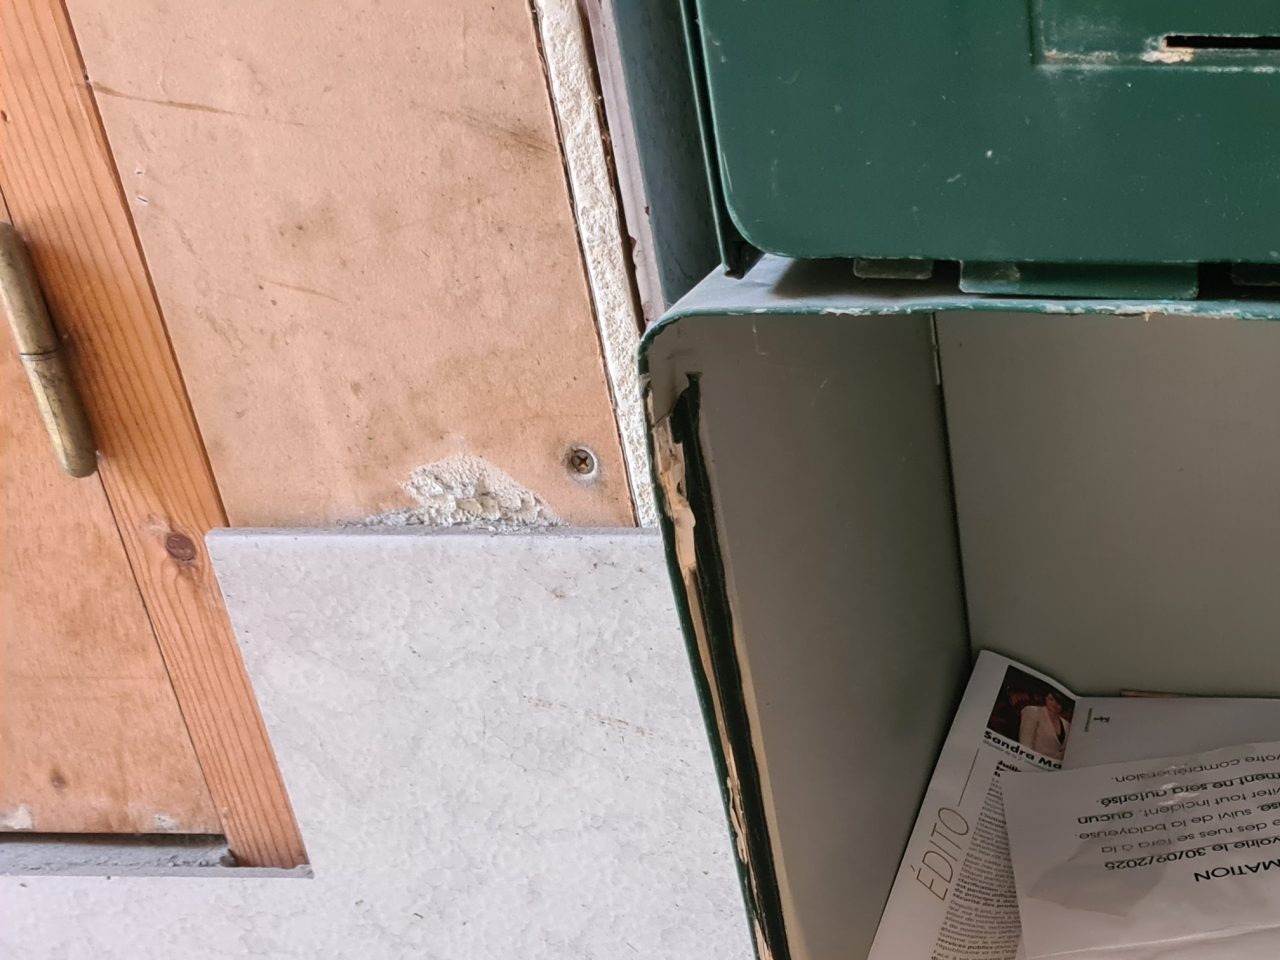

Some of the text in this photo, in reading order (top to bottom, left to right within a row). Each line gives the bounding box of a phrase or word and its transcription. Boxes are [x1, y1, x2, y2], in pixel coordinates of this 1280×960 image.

[983, 730, 1035, 762] Sandra
[1110, 757, 1240, 784] compréhension.
[1172, 782, 1209, 795] sera
[1212, 777, 1234, 790] ne
[1096, 786, 1169, 808] autorisé.
[1214, 792, 1248, 806] tout
[1138, 797, 1211, 818] incident,
[1217, 808, 1253, 820] suivi
[1077, 810, 1134, 825] aucun
[1190, 813, 1213, 825] de
[1074, 822, 1167, 841] balayeuse.
[1171, 820, 1187, 830] la
[1237, 820, 1267, 832] des
[1177, 833, 1195, 842] se
[1199, 827, 1233, 838] rues
[1101, 844, 1118, 854] la
[1121, 842, 1133, 852] à
[1138, 837, 1173, 849] fera
[1211, 841, 1229, 853] le
[909, 806, 970, 902] ÉDITO
[1103, 847, 1207, 872] 30/09/2025
